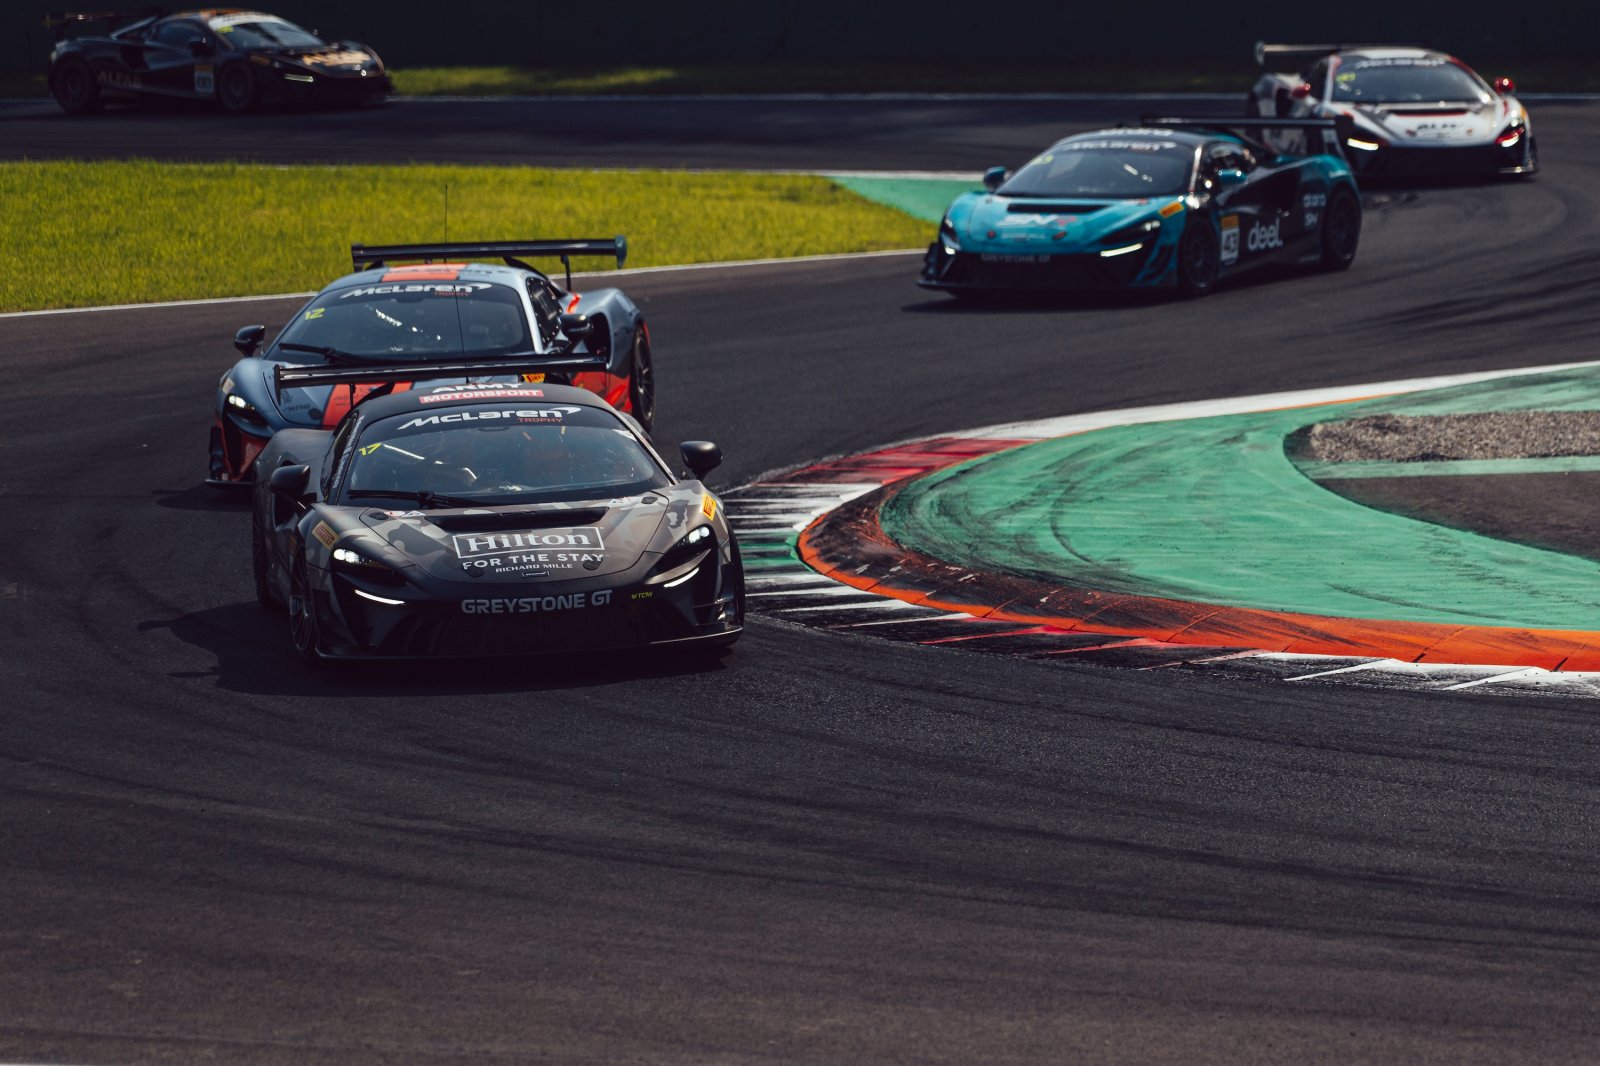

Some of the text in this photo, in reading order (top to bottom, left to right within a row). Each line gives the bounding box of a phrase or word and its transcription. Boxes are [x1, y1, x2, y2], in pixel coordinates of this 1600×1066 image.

[340, 284, 473, 299] McLaren
[303, 307, 326, 321] 12
[433, 382, 522, 394] ARMY
[423, 389, 540, 403] MOTORSPORT
[397, 408, 563, 431] McLaren
[359, 442, 382, 456] 17
[465, 532, 592, 553] Hilton
[462, 552, 604, 570] FOR THE STAY
[495, 563, 540, 573] RICHARD
[461, 589, 613, 614] GREYSTONE GT
